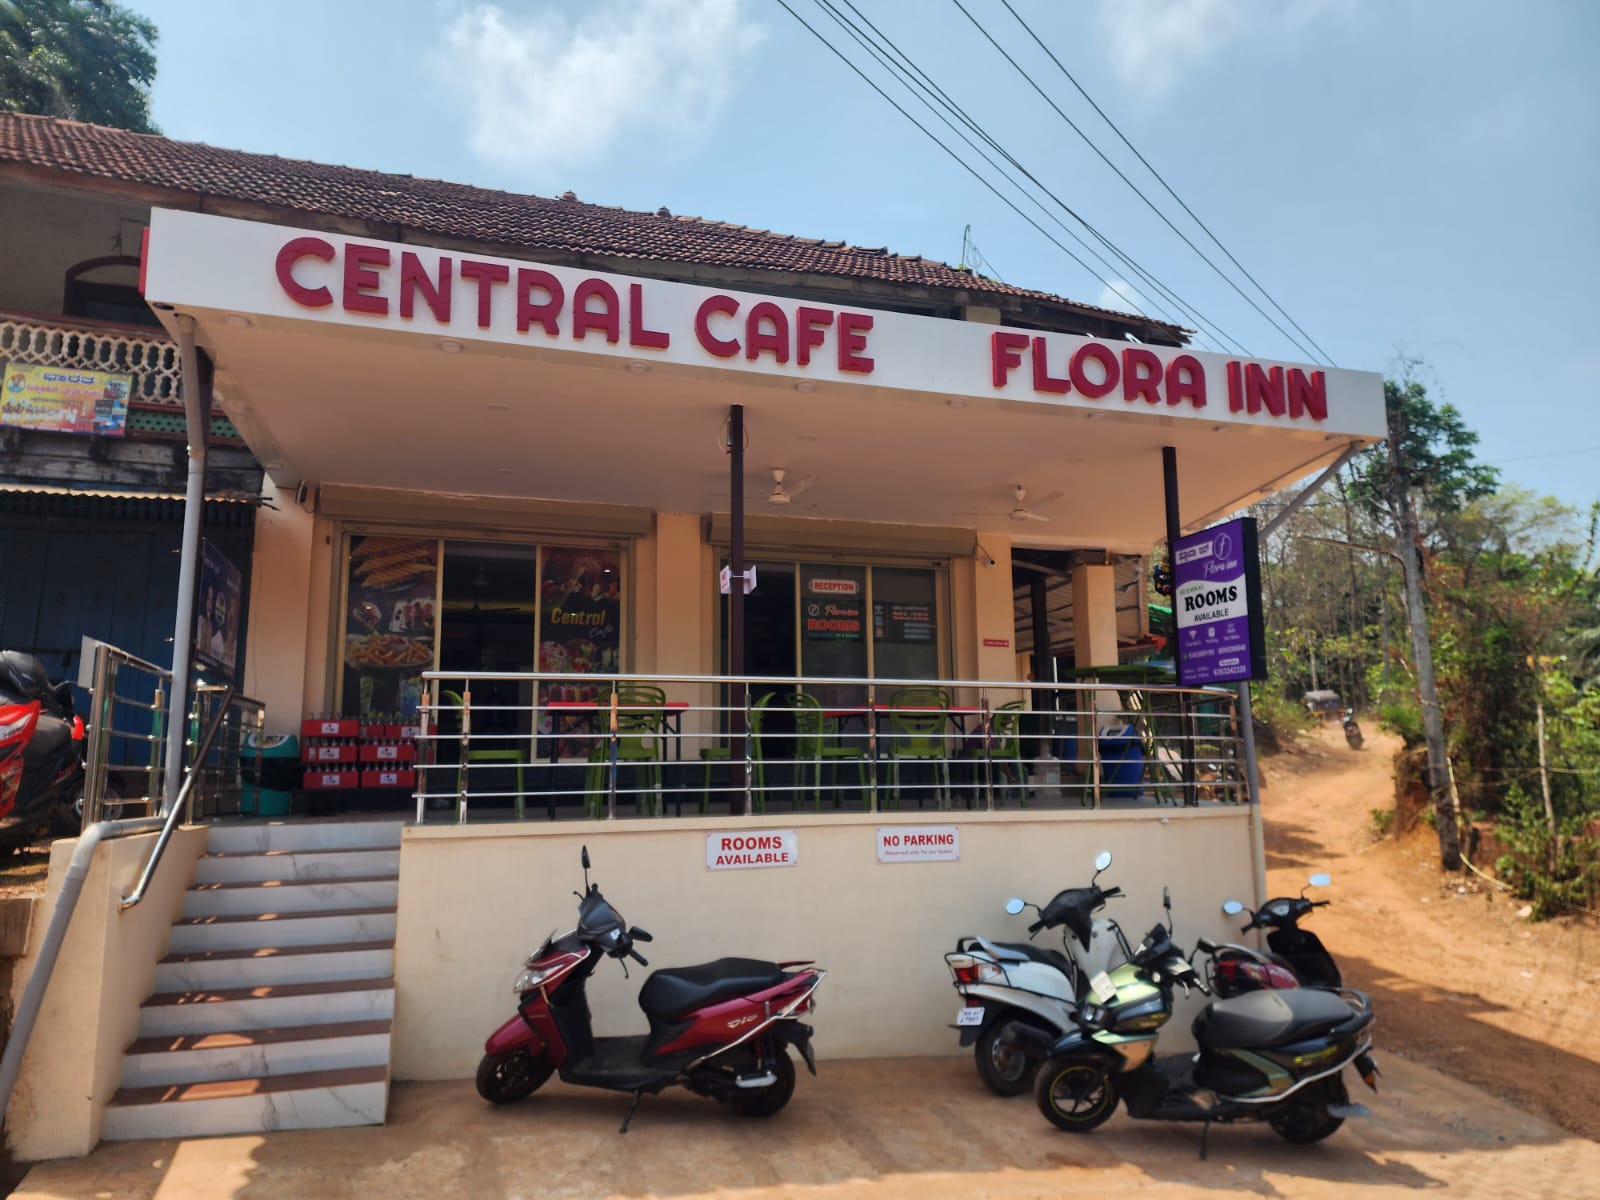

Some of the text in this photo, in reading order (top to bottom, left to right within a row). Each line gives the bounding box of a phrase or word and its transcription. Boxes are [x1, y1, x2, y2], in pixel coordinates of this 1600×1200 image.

[275, 237, 874, 373] CENTRAL CAFE
[992, 332, 1328, 421] FLORA INN
[814, 581, 854, 592] RECEPTION
[1184, 585, 1237, 612] ROOMS
[551, 608, 606, 625] Central
[1194, 608, 1229, 622] AVAILABLE
[807, 618, 859, 632] ROOMS
[721, 836, 782, 851] ROOMS
[883, 834, 954, 847] NO PARKING
[716, 852, 789, 866] AVAILABLE
